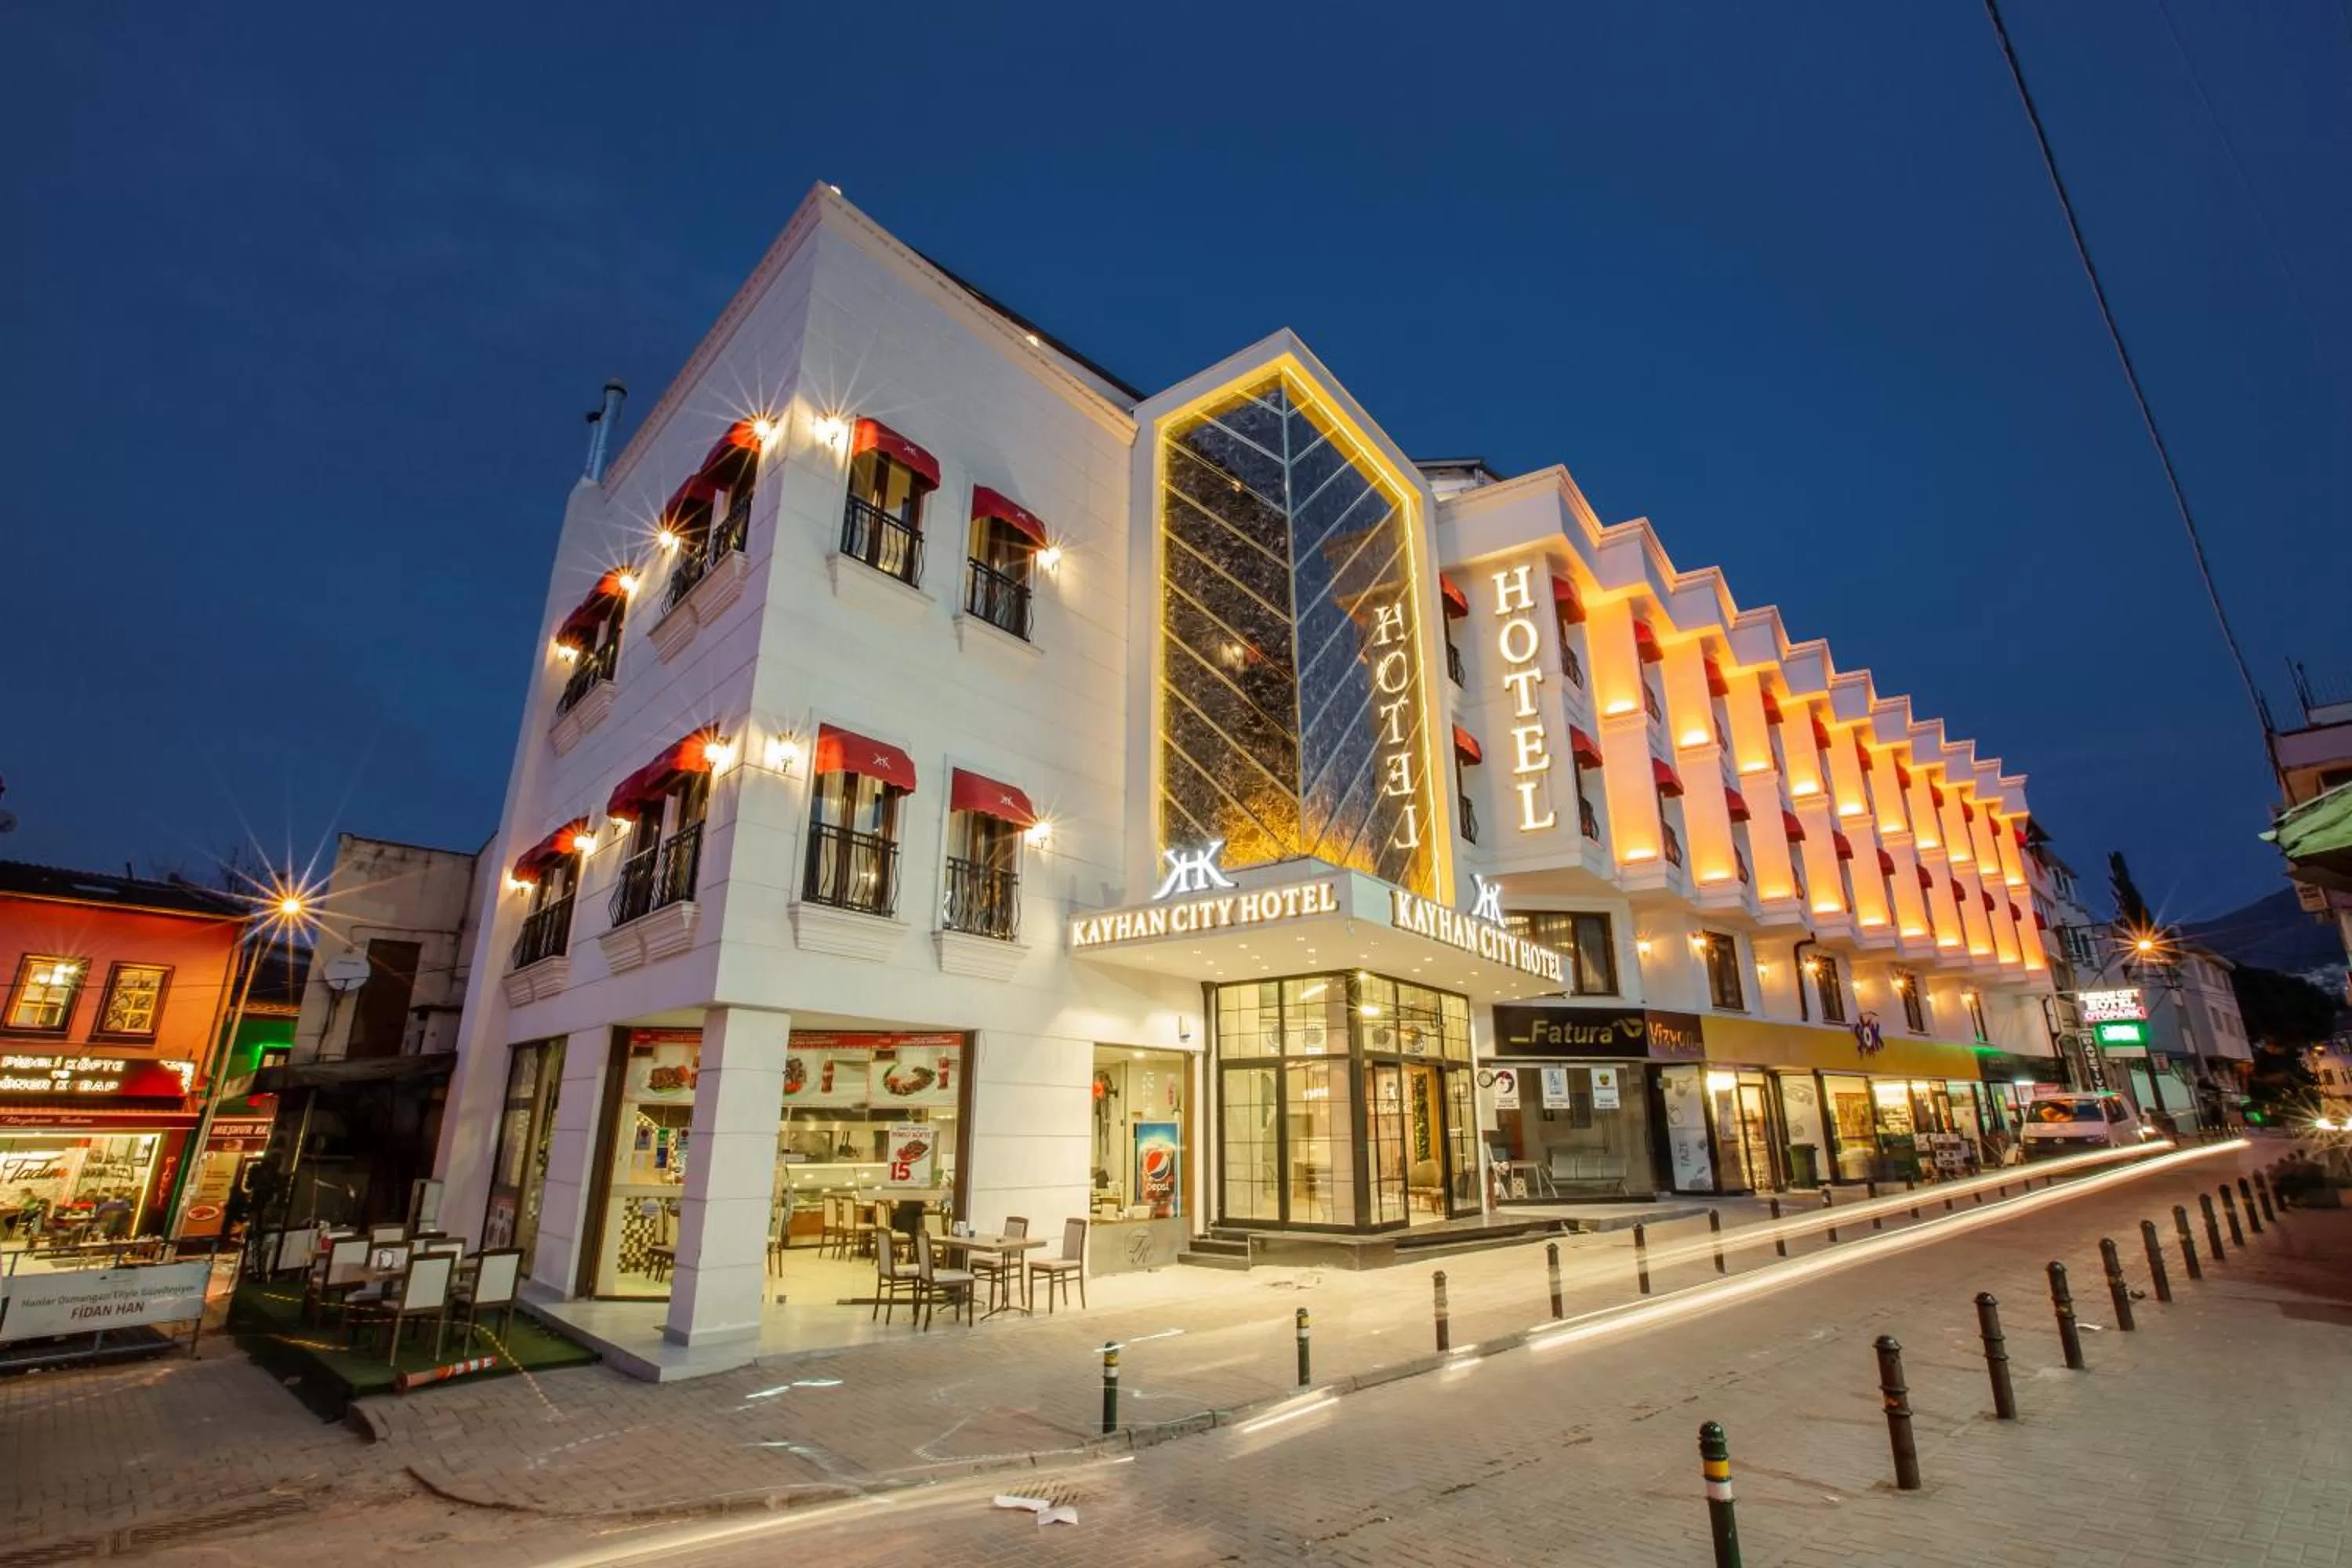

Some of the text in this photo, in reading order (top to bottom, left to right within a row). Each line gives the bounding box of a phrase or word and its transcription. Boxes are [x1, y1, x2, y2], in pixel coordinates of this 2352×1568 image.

[1492, 565, 1556, 833] HOTEL
[1072, 882, 1340, 947] KAYHAN CITY HOTEL
[1391, 890, 1565, 983] KAYHAN CITY HOTEL
[2084, 1008, 2139, 1021] OTOPARK
[2086, 999, 2136, 1011] HOTEL
[1531, 1019, 1614, 1045] Fatura
[890, 1161, 912, 1181] 15
[1146, 1180, 1171, 1193] pepsi
[71, 1301, 145, 1319] FİDAN HAN
